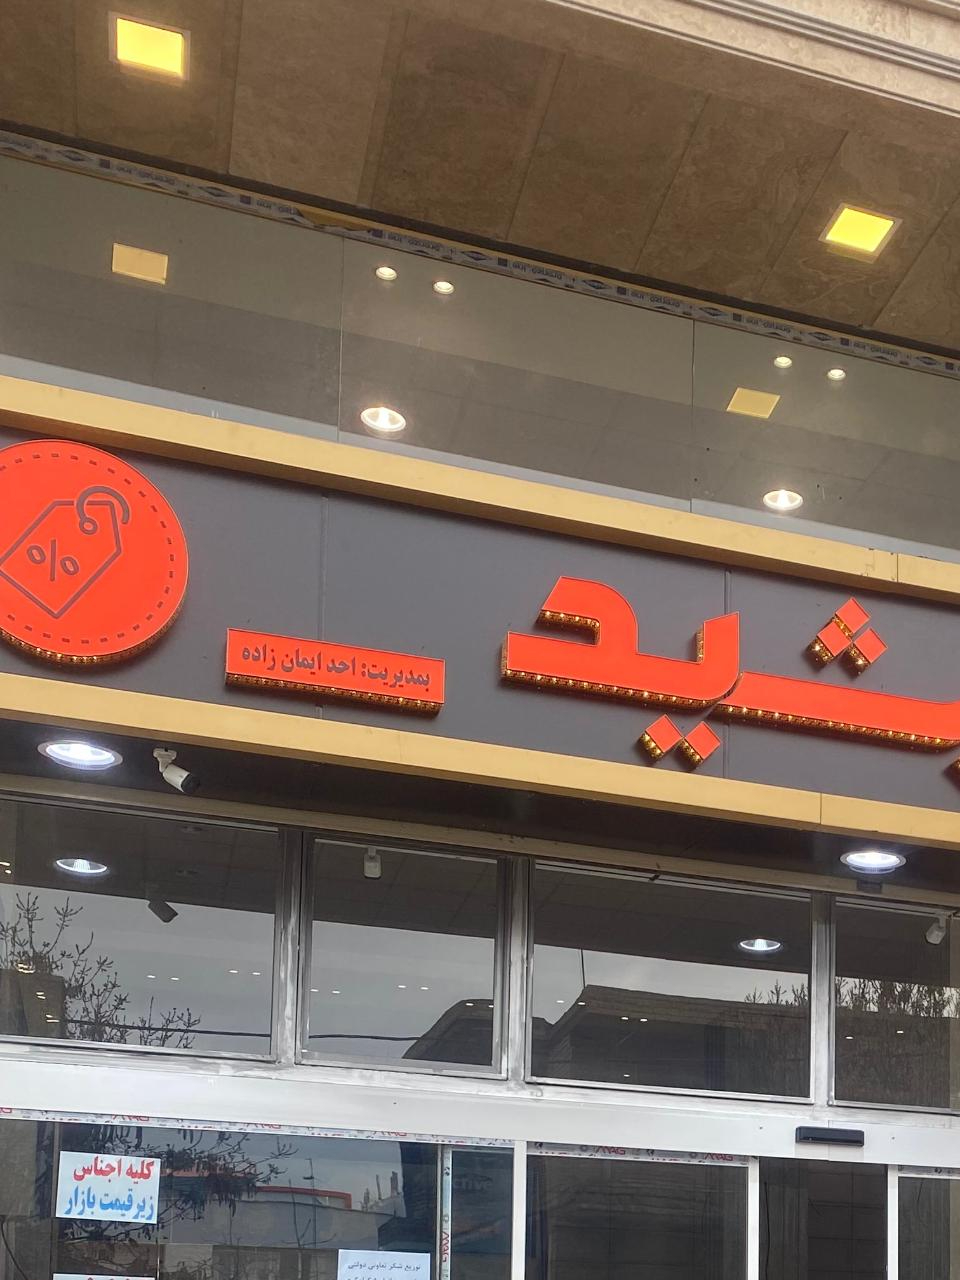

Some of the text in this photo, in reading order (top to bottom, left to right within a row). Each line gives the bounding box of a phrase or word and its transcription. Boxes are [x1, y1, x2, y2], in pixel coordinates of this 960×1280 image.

[242, 643, 431, 692] بمدیریت: احد ایمان زاده
[73, 1155, 154, 1184] کلیه اجناس
[64, 1185, 154, 1220] زیر قیمت بازار
